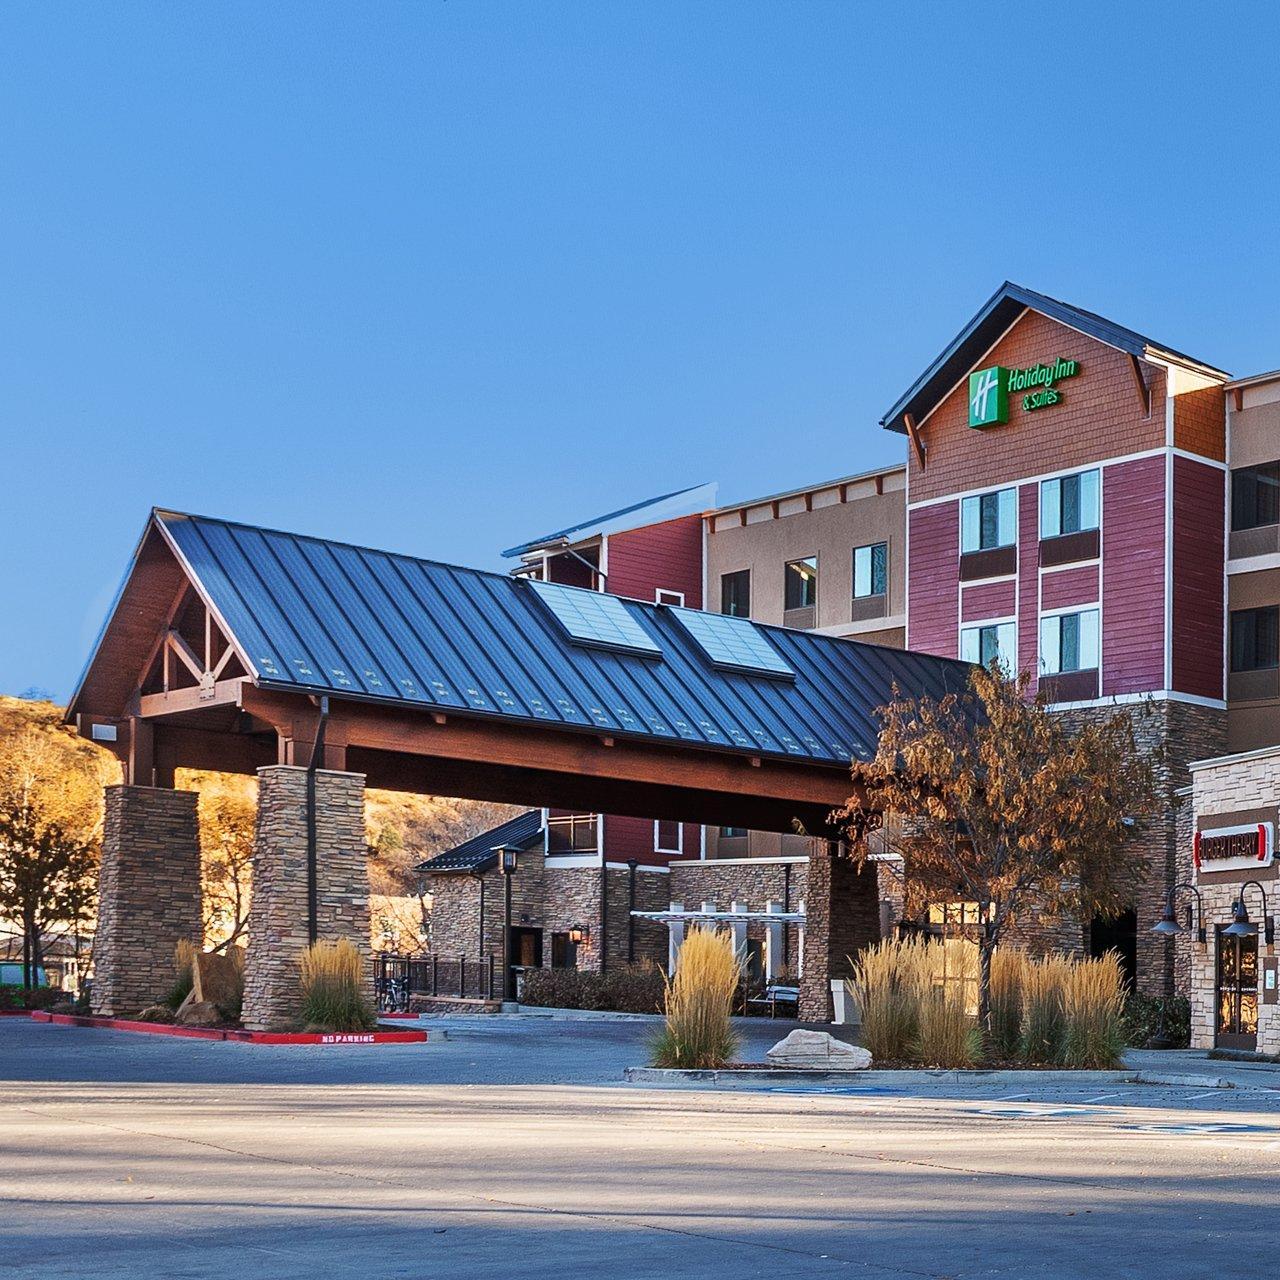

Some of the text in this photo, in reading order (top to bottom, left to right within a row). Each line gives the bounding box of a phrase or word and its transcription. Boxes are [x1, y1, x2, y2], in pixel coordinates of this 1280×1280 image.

[1007, 357, 1077, 391] Holiday Inn
[1022, 389, 1059, 411] & Suites
[335, 1035, 375, 1043] PARKING
